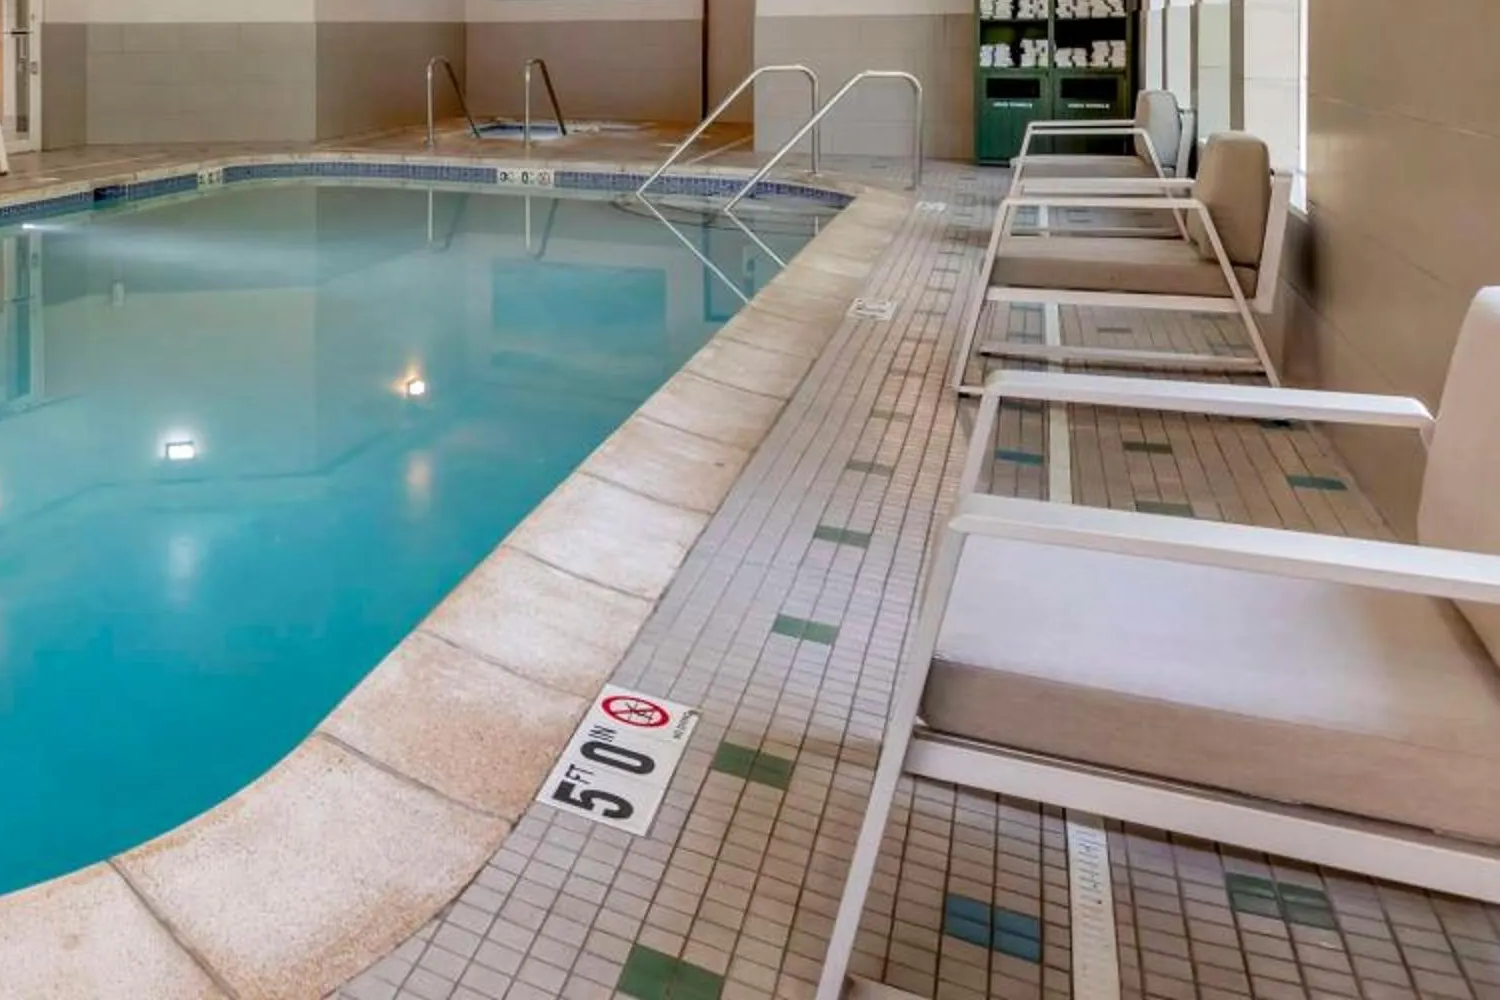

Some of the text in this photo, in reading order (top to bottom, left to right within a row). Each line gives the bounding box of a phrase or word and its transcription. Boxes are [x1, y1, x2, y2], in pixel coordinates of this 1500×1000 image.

[564, 763, 594, 785] FT
[580, 740, 655, 775] 0
[552, 780, 634, 819] 5
